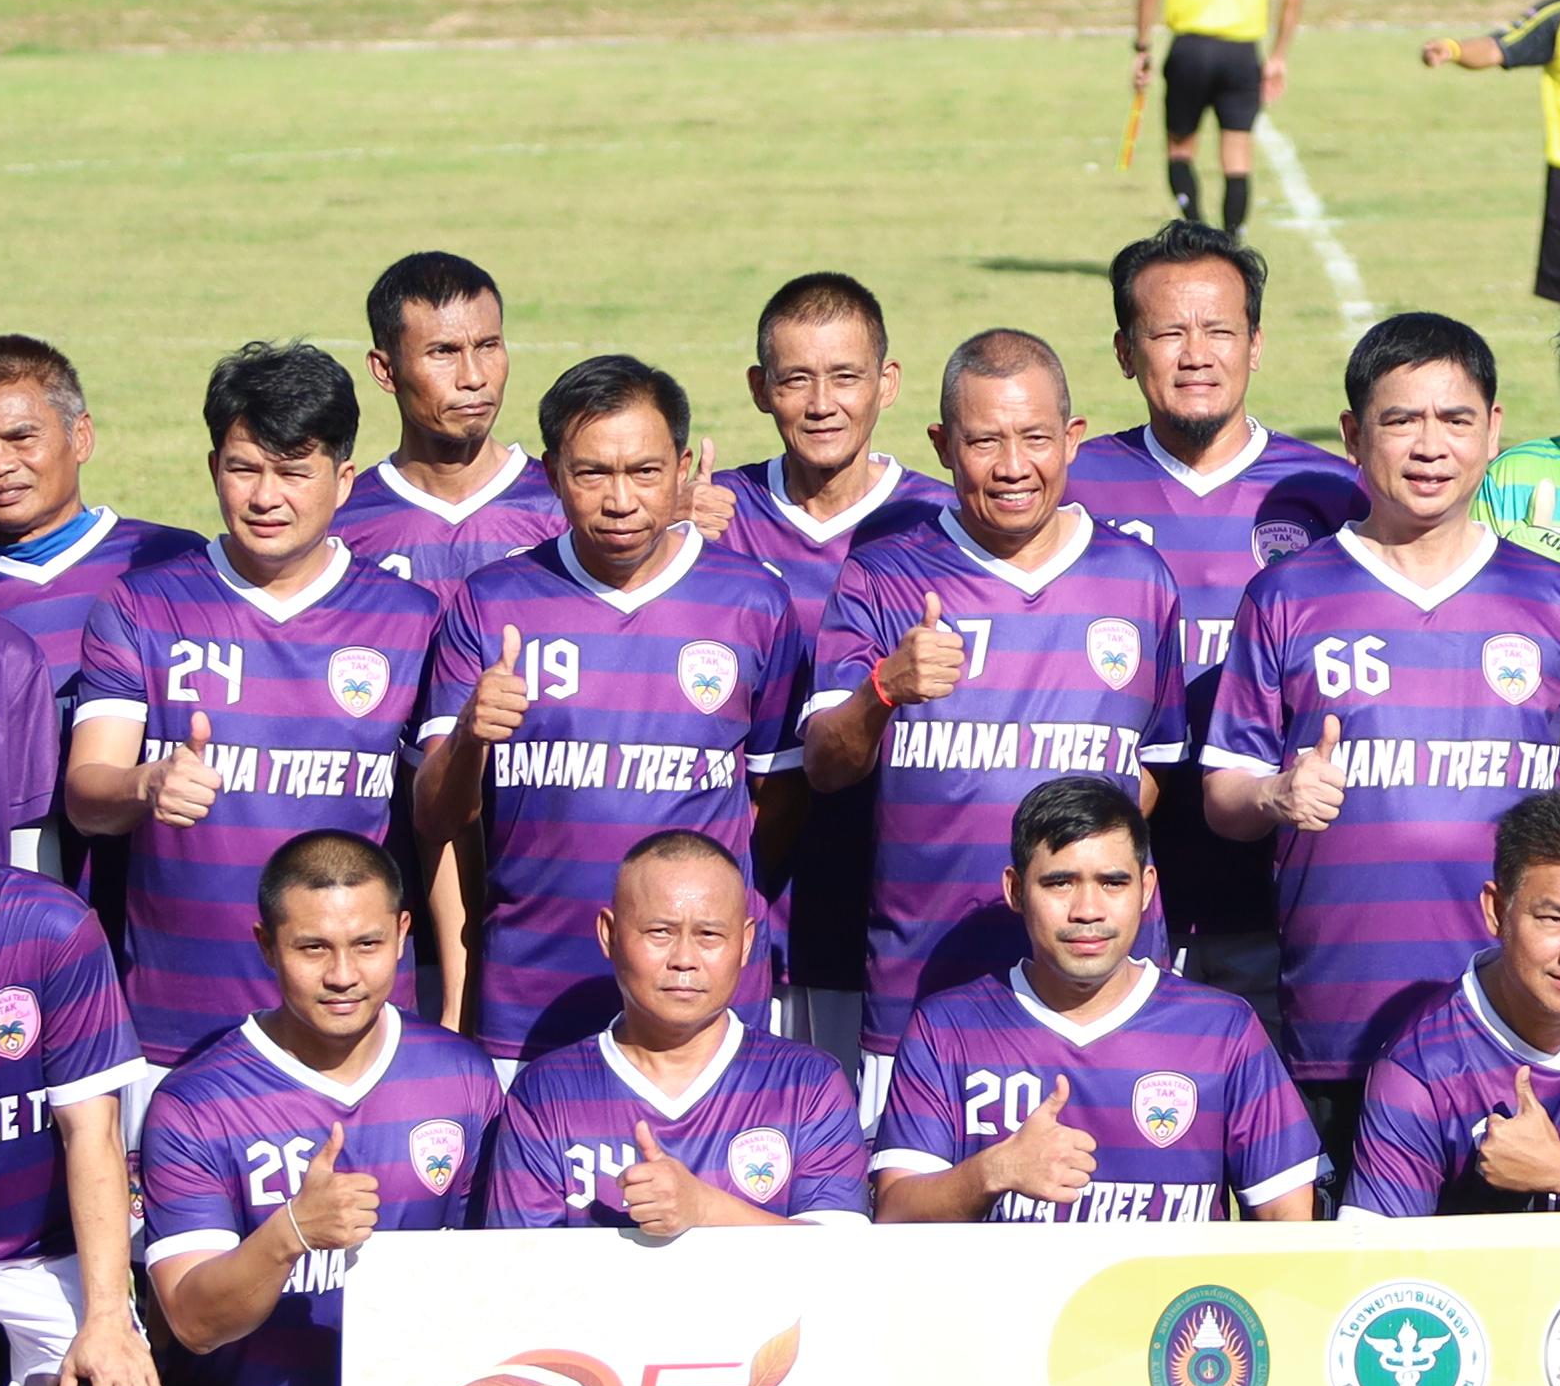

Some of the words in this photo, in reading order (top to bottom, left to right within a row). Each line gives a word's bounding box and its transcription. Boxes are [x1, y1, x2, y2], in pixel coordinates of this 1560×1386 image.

[168, 640, 244, 704] 24
[525, 637, 580, 702] 19
[1314, 635, 1392, 699] 66
[267, 749, 351, 800] TREE
[495, 740, 608, 789] BANANA
[618, 743, 699, 794] TREE
[890, 720, 1020, 773] BANANA
[1027, 721, 1110, 773] TREE
[1425, 740, 1512, 791] TREE
[965, 1069, 1042, 1135] 20
[564, 1143, 636, 1209] 34
[1077, 1181, 1156, 1223] TREE
[1161, 1183, 1218, 1223] TAK
